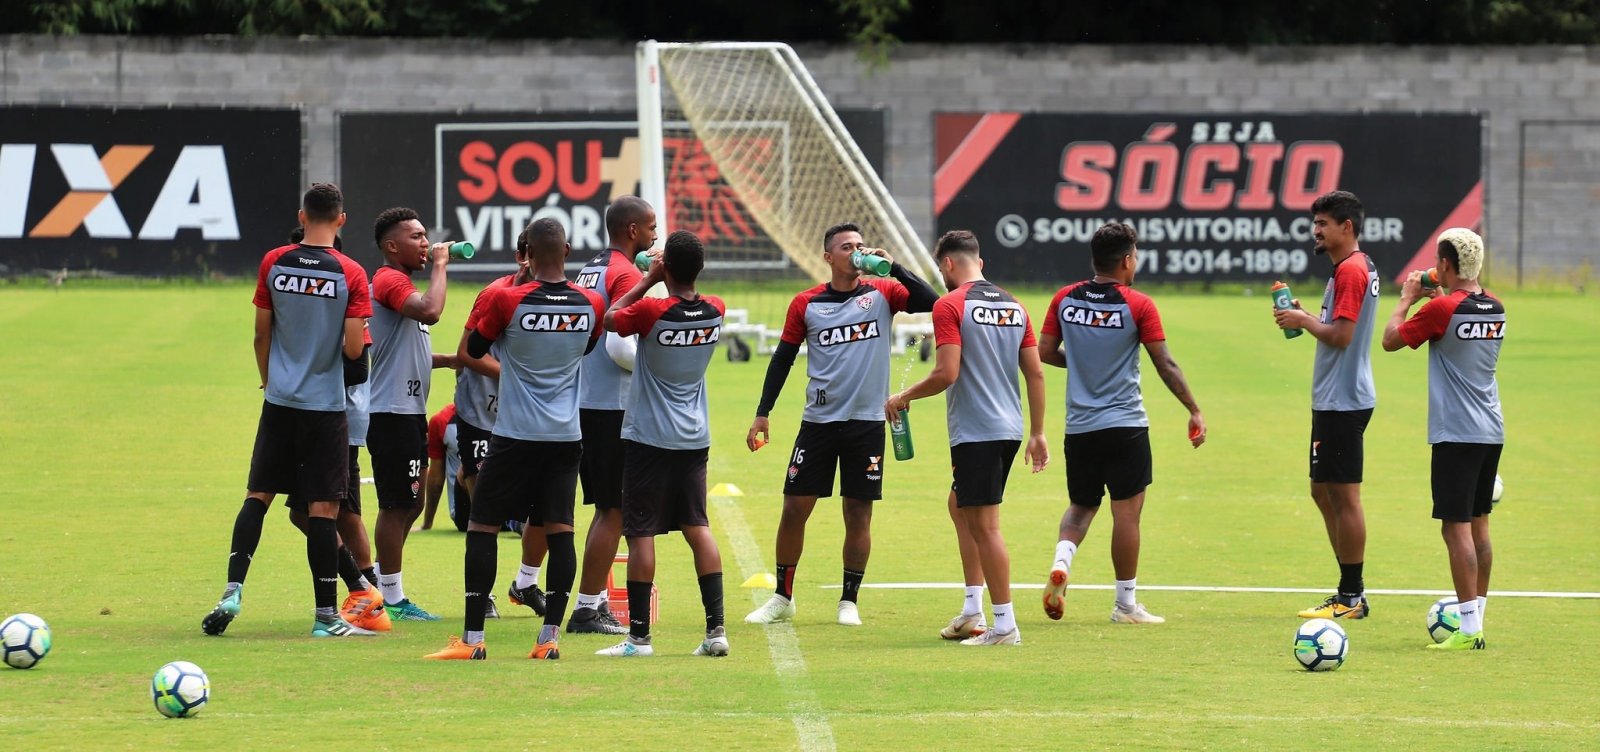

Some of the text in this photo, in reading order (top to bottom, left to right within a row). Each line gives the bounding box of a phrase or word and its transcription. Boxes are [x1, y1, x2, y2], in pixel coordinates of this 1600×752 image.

[1191, 121, 1275, 142] SEJA
[1055, 122, 1343, 211] SÓCIO
[299, 257, 320, 265] Topper
[1165, 249, 1308, 274] 3014-1899
[274, 275, 335, 297] CAIXA
[1085, 291, 1106, 299] Topper
[521, 313, 588, 331] CAIXA
[973, 307, 1023, 326] CAIXA
[1062, 306, 1122, 327] CAIXA
[658, 326, 720, 346] CAIXA
[818, 321, 878, 346] CAIXA
[407, 380, 421, 397] 32
[815, 387, 826, 406] 16
[471, 439, 489, 458] 73
[792, 446, 806, 464] 16
